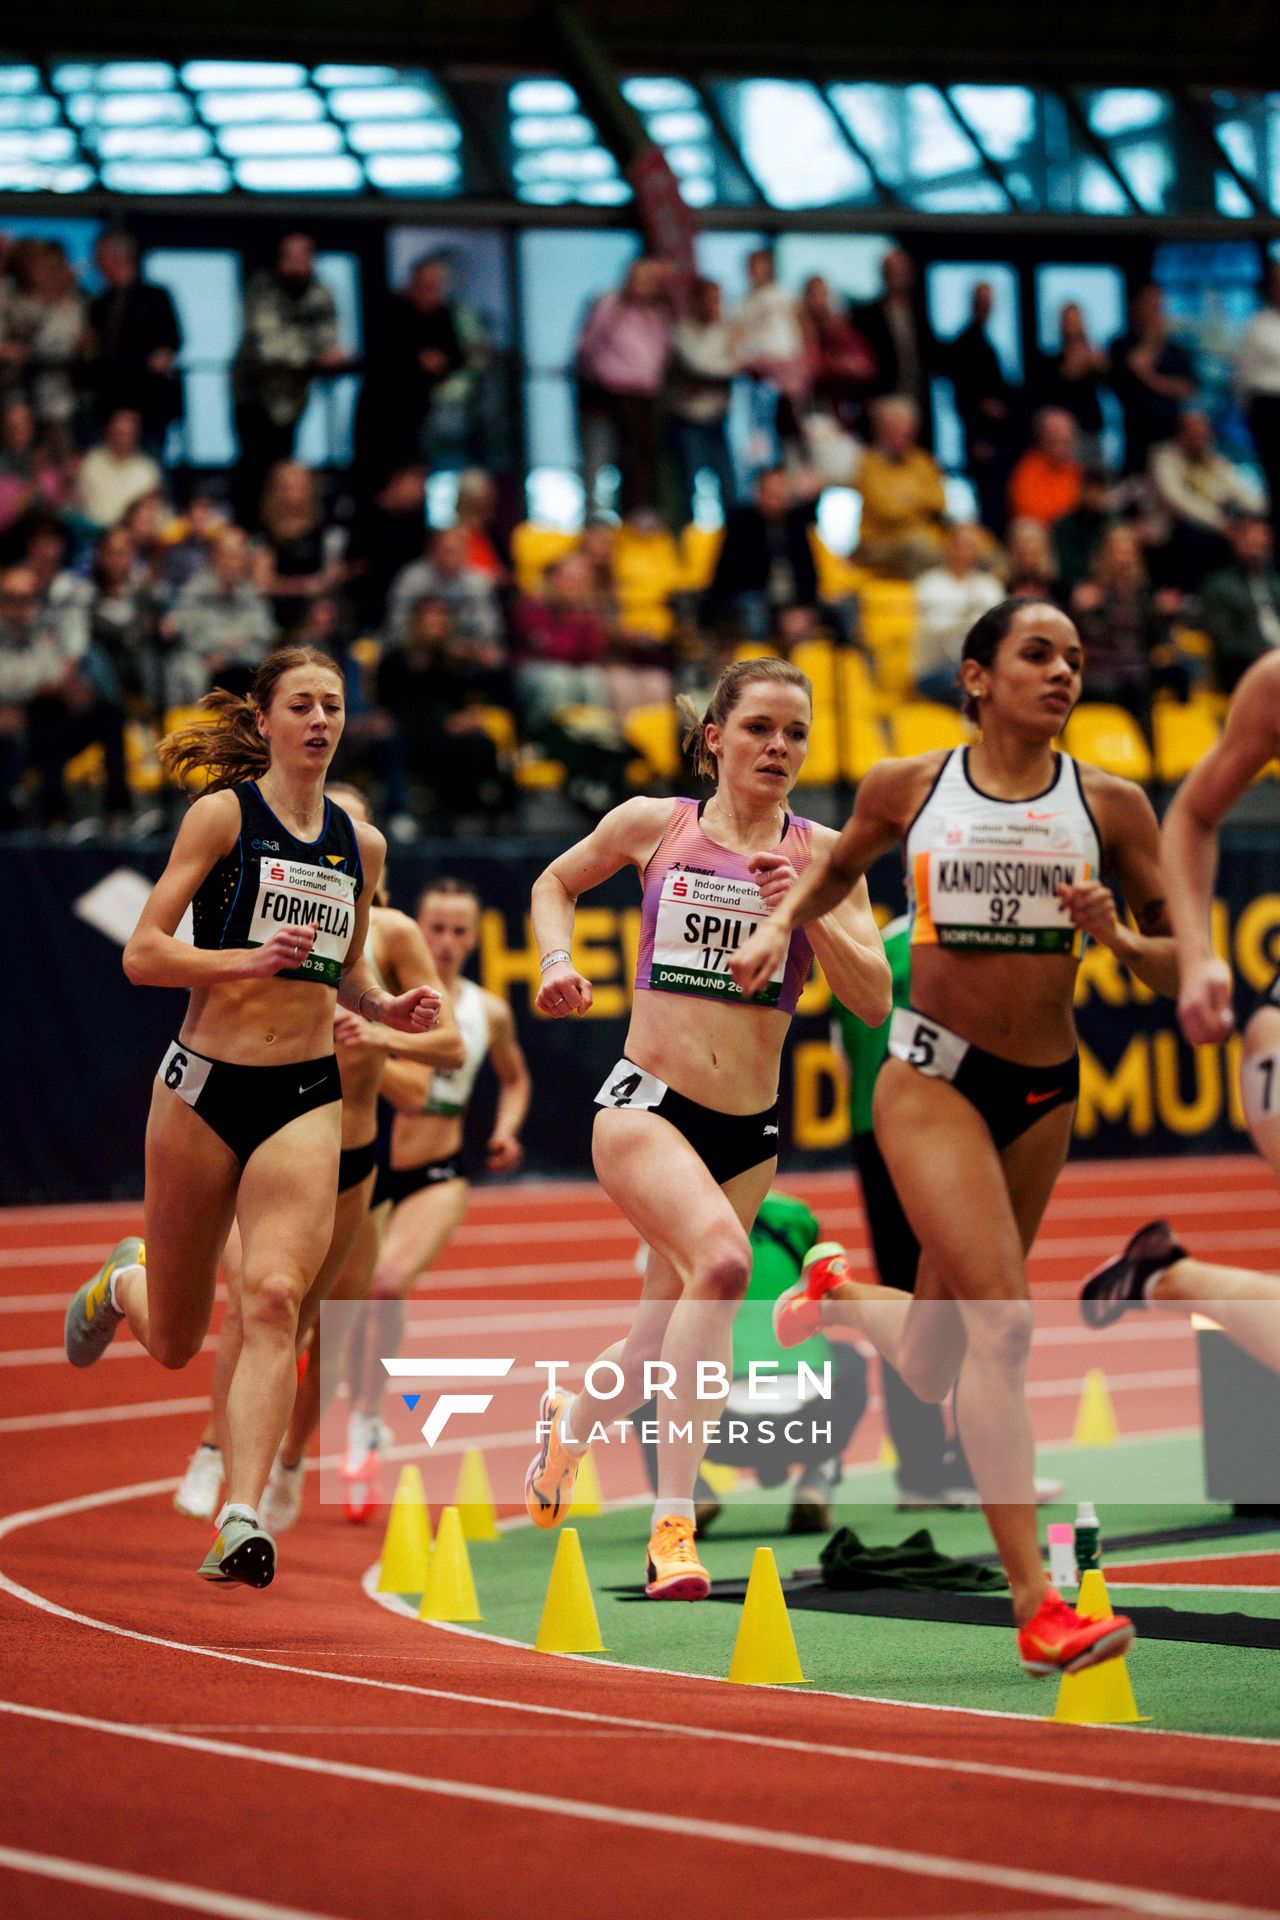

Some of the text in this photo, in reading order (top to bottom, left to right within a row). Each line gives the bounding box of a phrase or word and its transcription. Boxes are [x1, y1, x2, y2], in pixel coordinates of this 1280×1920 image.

[289, 866, 342, 886] Indoor Meeting
[289, 876, 327, 891] Dortmund
[692, 891, 741, 906] Dortmund
[694, 879, 764, 899] Indoor Meetin
[261, 892, 349, 939] FORMELLA
[990, 898, 1021, 925] 92
[313, 961, 325, 972] 26
[660, 971, 726, 990] DORTMUND
[909, 1024, 939, 1067] 5
[165, 1052, 188, 1090] 6
[610, 1072, 643, 1108] 4
